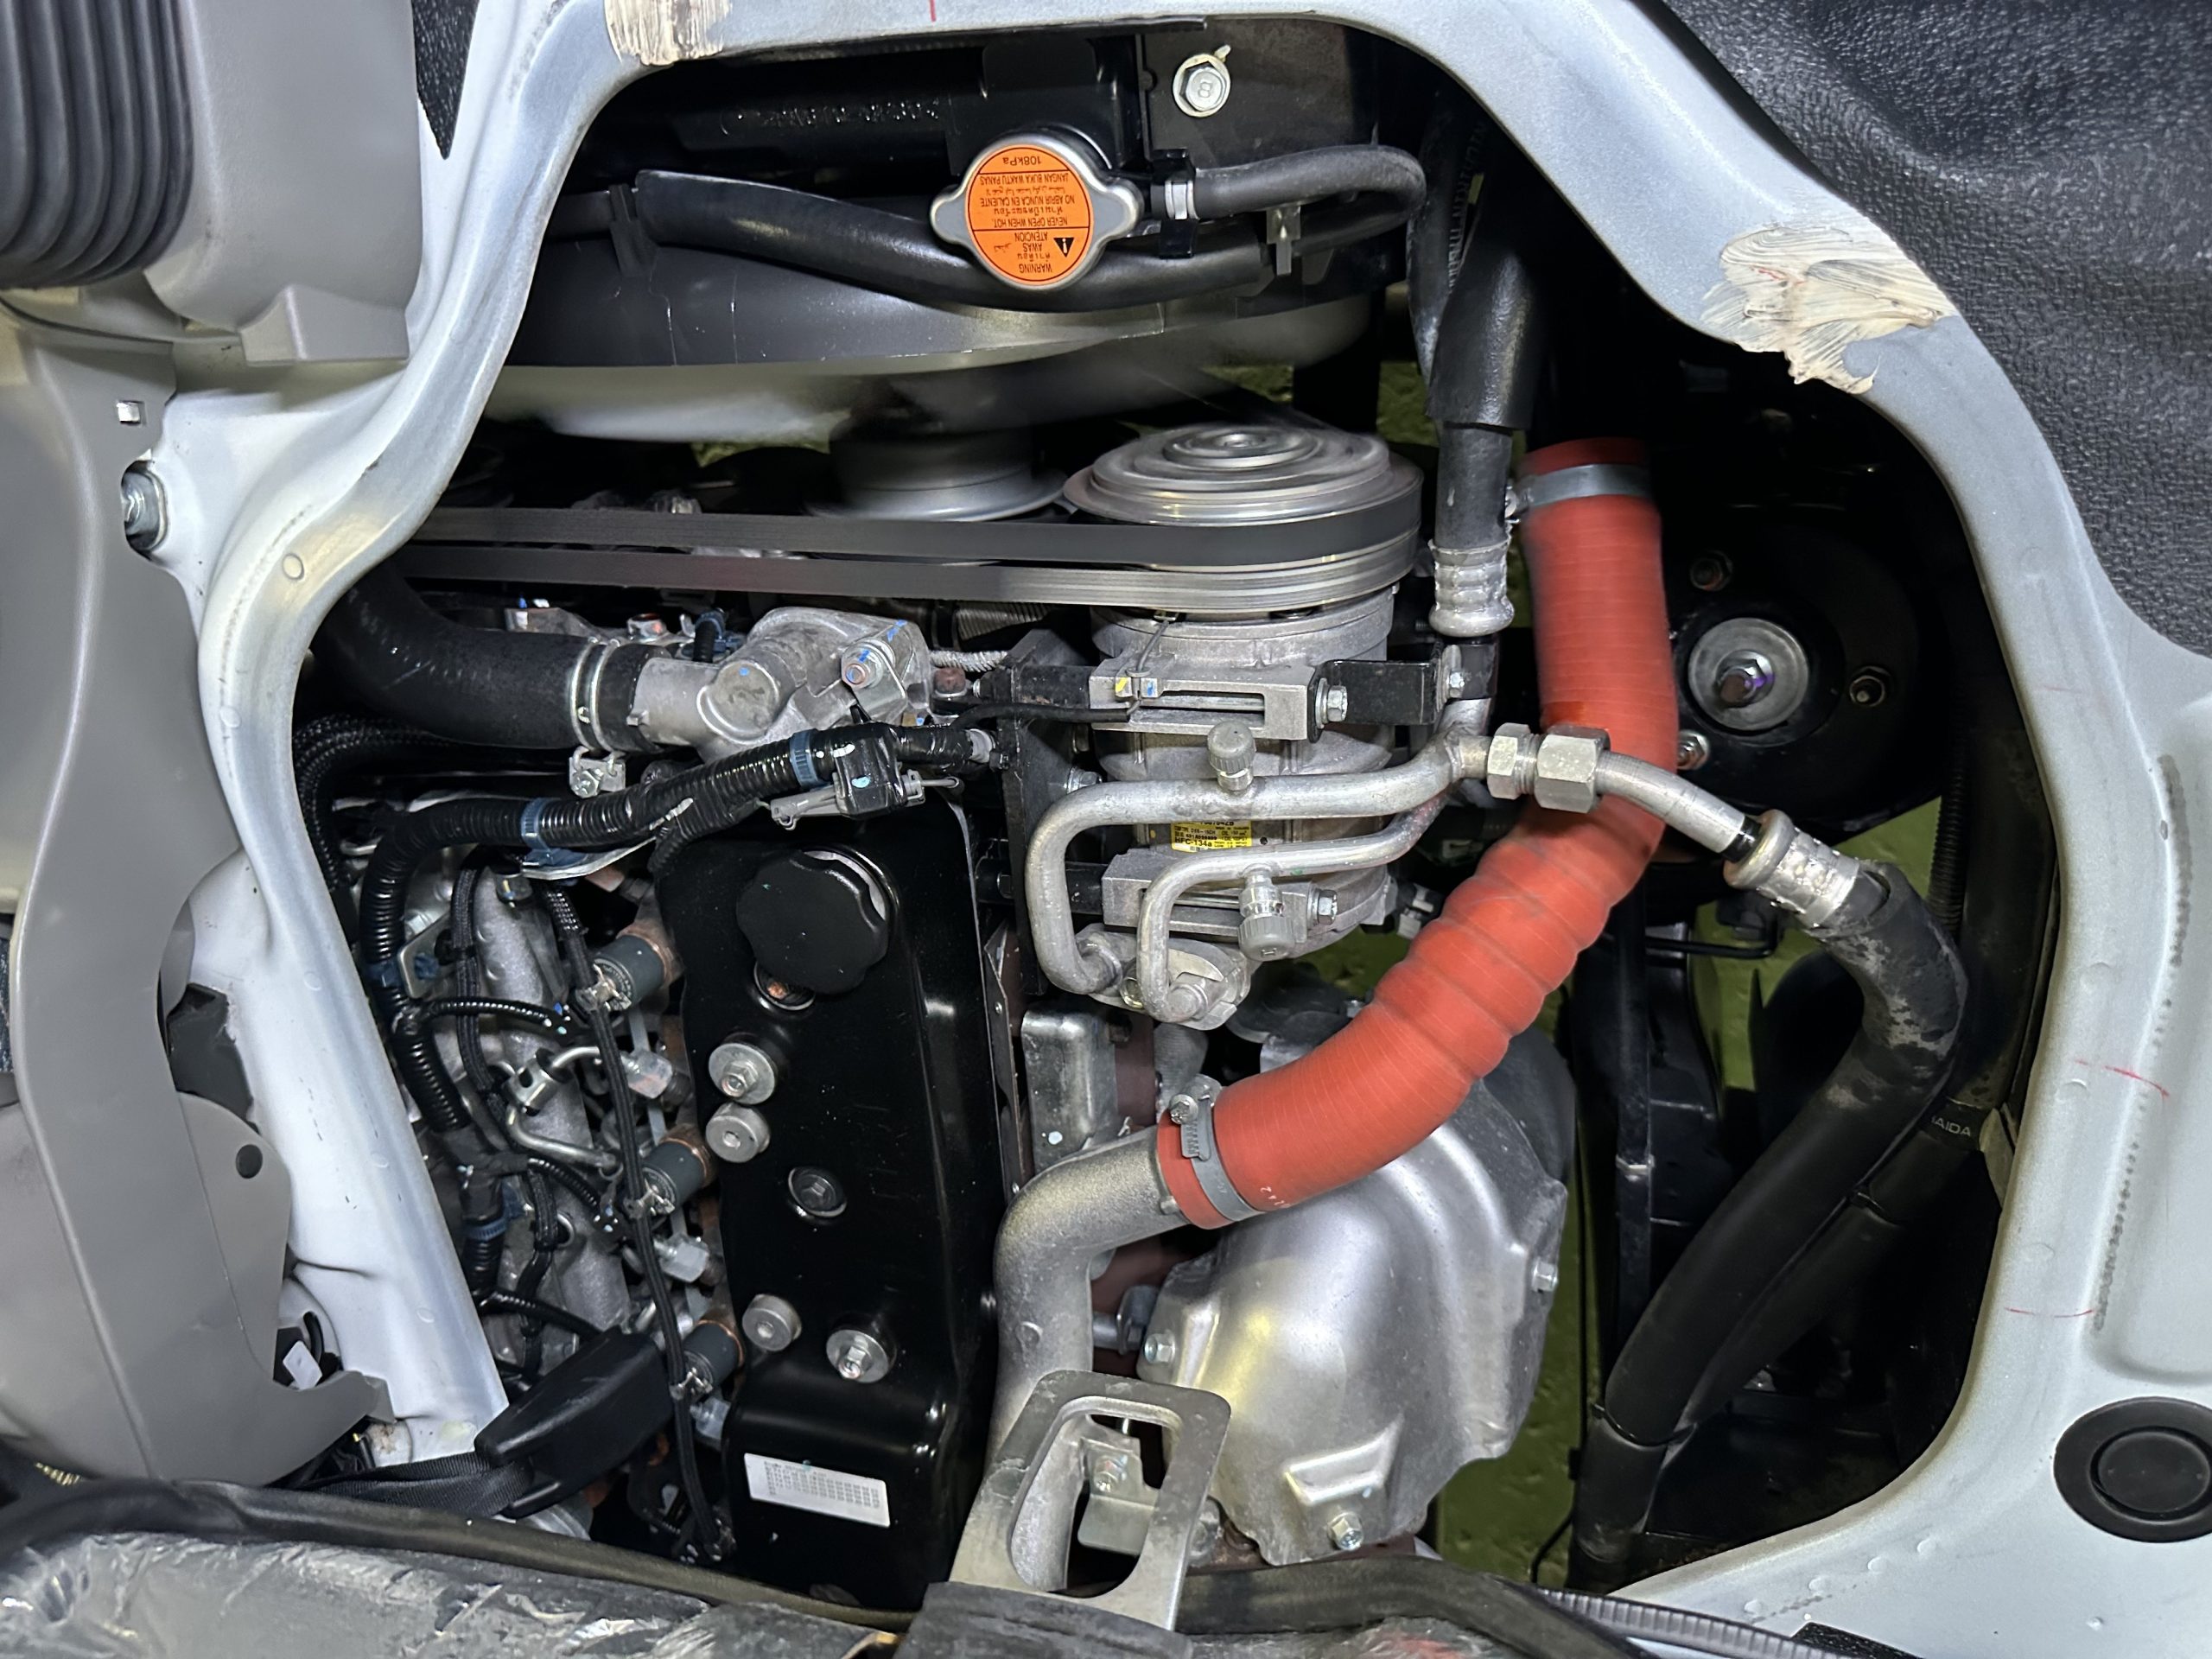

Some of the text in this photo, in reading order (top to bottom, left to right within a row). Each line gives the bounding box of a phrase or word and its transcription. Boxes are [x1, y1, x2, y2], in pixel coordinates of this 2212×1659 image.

[1002, 156, 1041, 165] 108kPa
[980, 174, 1068, 185] JANGAN BUKA WAKTU PANAS
[980, 198, 1009, 207] CALIENTE
[1011, 197, 1020, 206] EN
[1021, 196, 1043, 205] NUNCA
[1046, 195, 1063, 204] ABRIR
[1027, 218, 1045, 226] OPEN
[1047, 217, 1067, 226] NEVER
[1014, 232, 1047, 242] ATENCION
[1019, 264, 1052, 273] WARNING
[1175, 836, 1212, 847] HFC-134a
